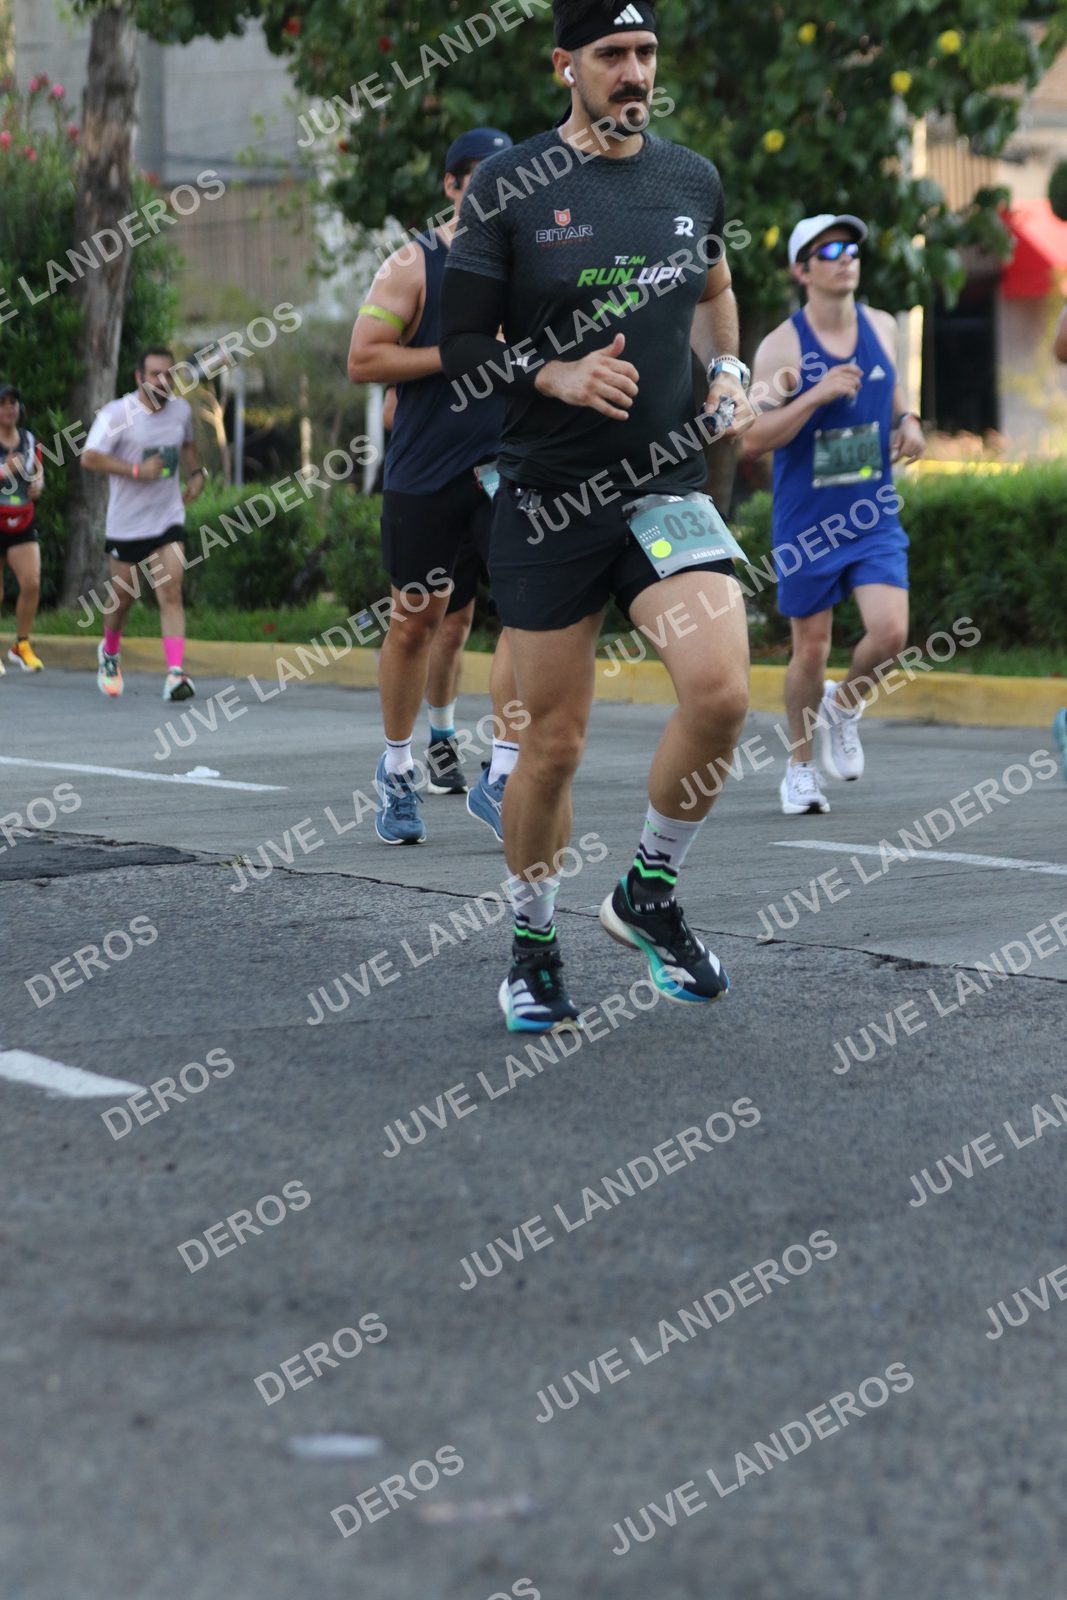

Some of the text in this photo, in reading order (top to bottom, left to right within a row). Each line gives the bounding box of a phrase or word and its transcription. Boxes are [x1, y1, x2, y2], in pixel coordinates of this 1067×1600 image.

[536, 224, 594, 243] BITAR
[614, 255, 646, 265] TEAM
[577, 267, 682, 287] RUN UP!
